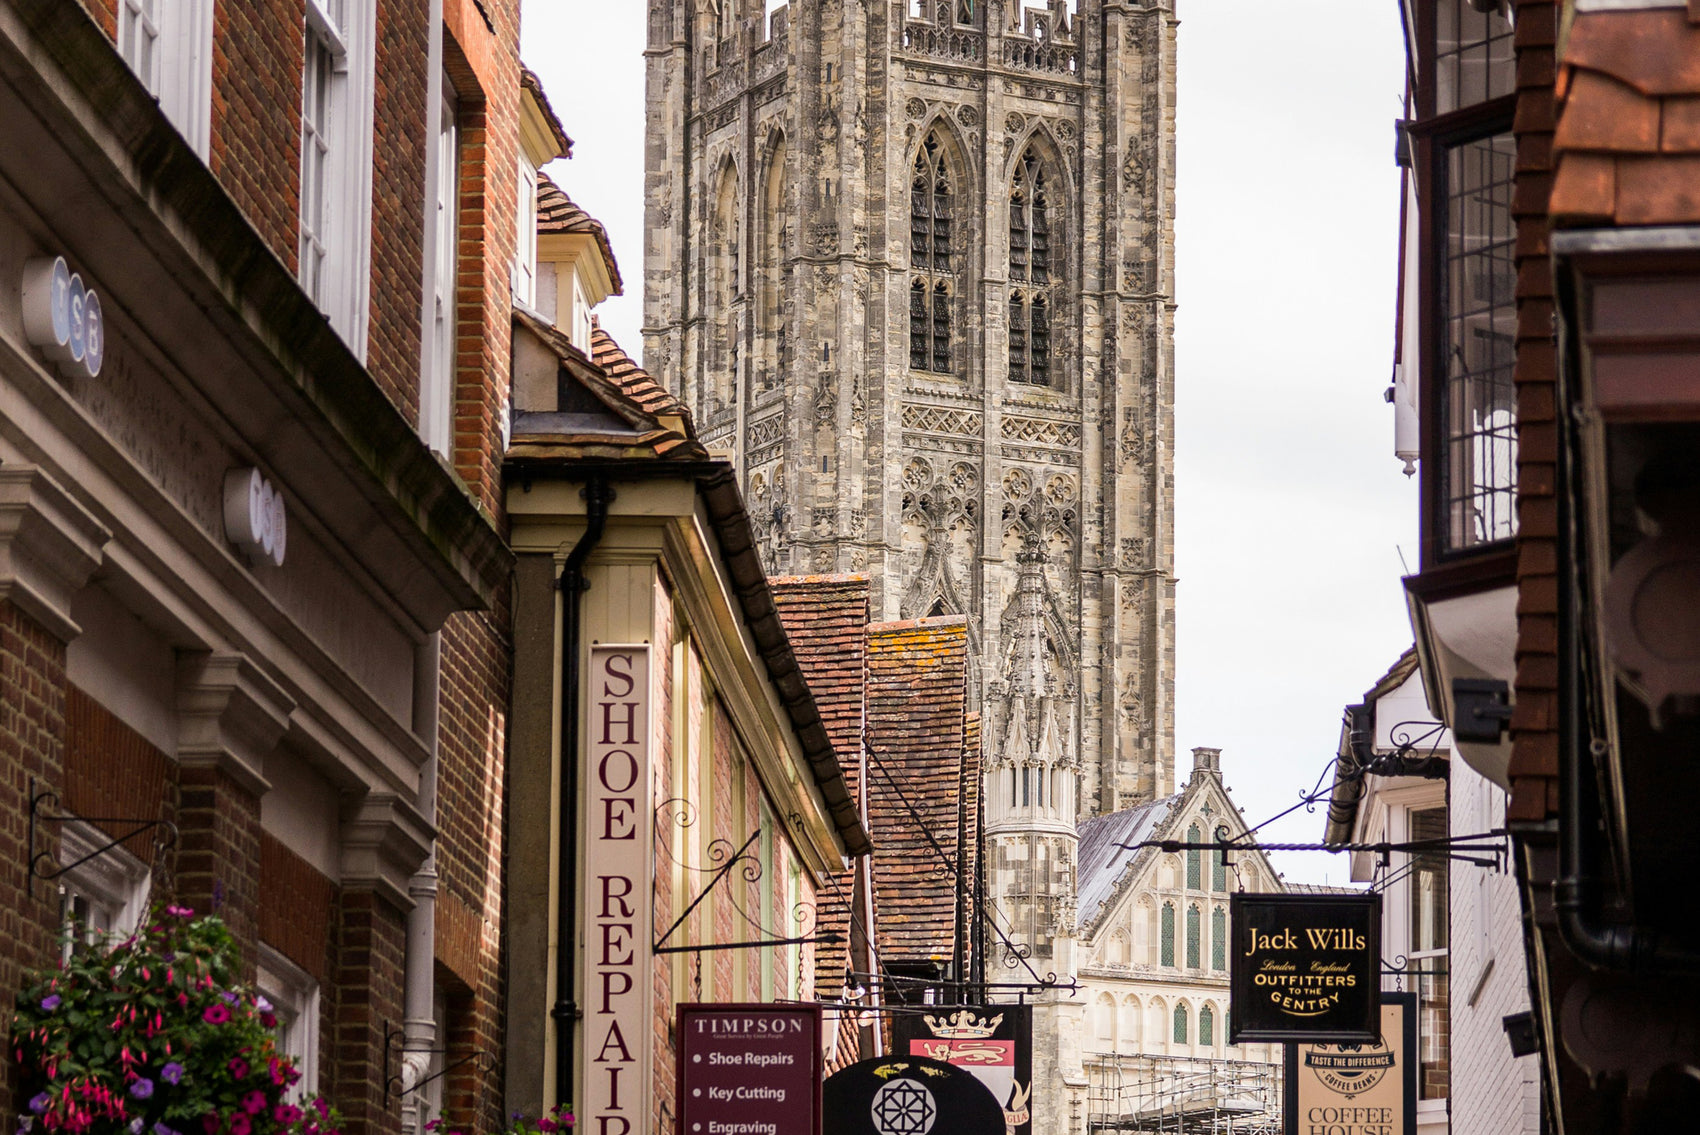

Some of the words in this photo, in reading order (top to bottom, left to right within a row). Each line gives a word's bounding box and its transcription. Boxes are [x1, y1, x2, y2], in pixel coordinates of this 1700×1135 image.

[57, 276, 99, 356] TSB
[597, 654, 640, 840] SHOE
[1245, 927, 1298, 957] Jack
[1305, 927, 1366, 951] Wills
[1260, 959, 1297, 972] London
[1310, 960, 1351, 975] England
[1254, 973, 1356, 987] OUTFITTERS
[1288, 987, 1302, 995] TO
[1303, 987, 1322, 996] THE
[1270, 991, 1340, 1011] GENTRY
[694, 1018, 803, 1033] TIMPSON
[708, 1052, 742, 1065] Shoe
[744, 1052, 794, 1068] Repairs
[1311, 1055, 1331, 1066] TASTE
[1333, 1056, 1346, 1067] THE
[1347, 1055, 1390, 1067] DIFFERENCE
[1324, 1073, 1350, 1091] COFFEE
[1352, 1073, 1377, 1091] BEANS
[708, 1086, 734, 1102] Key
[735, 1086, 786, 1102] Cutting
[1308, 1106, 1393, 1124] COFFEE
[708, 1120, 777, 1135] Engraving
[1308, 1125, 1393, 1135] HOUSE
